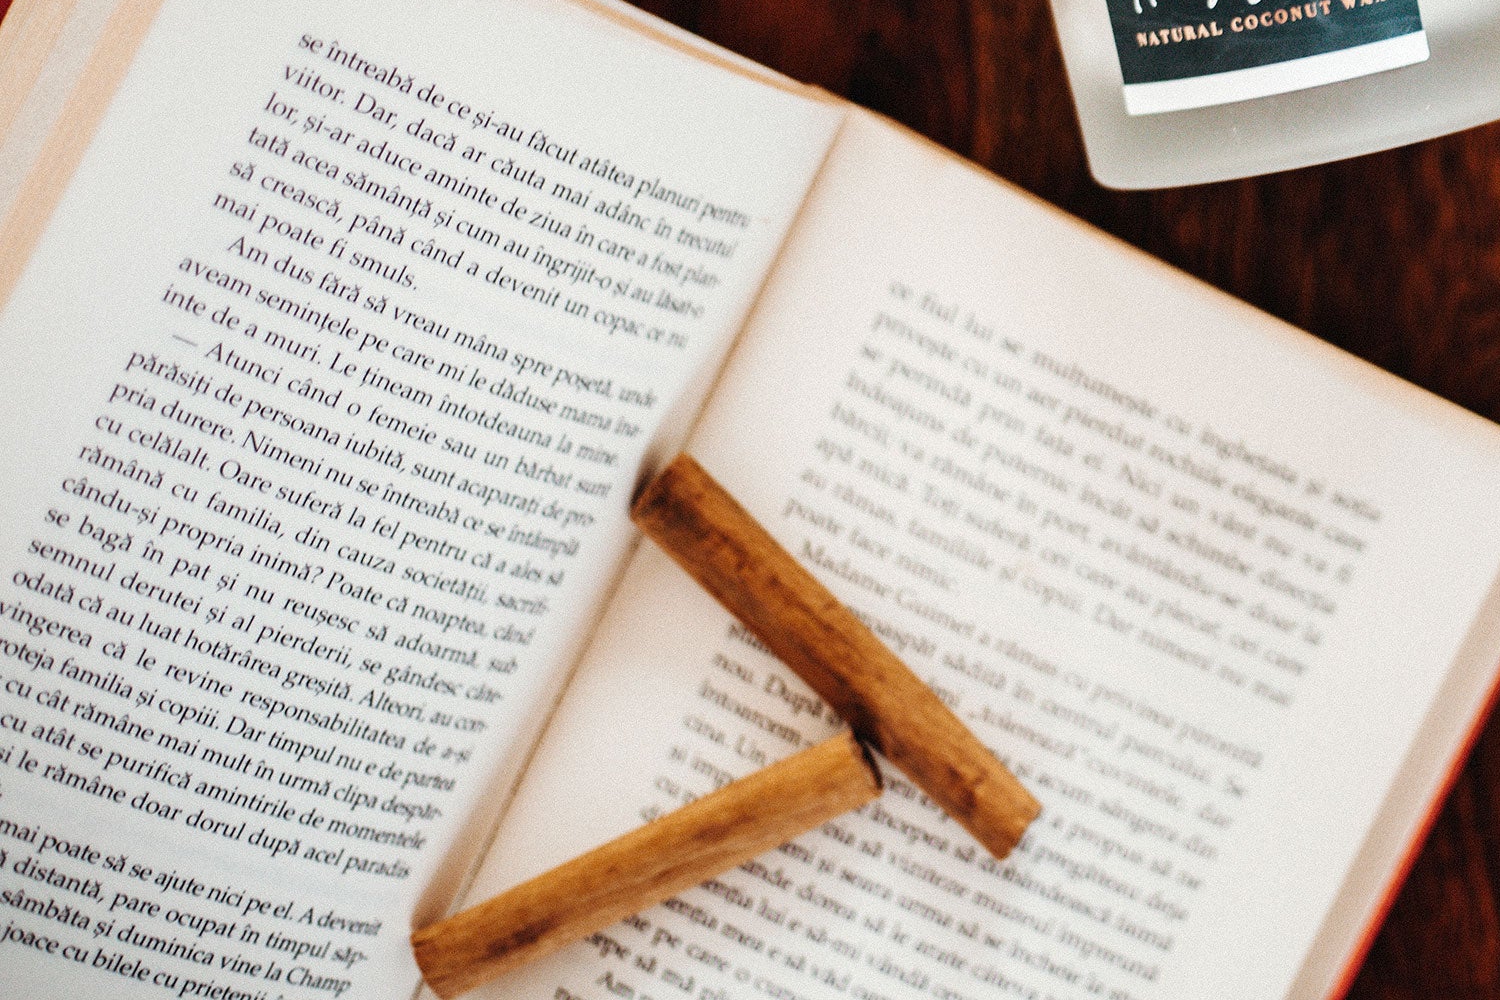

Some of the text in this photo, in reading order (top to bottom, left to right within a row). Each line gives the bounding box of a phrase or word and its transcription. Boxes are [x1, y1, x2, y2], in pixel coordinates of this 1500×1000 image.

[1134, 20, 1224, 48] NATURAL
[282, 63, 547, 192] viitor. Dar, dacă ar căuta
[296, 32, 580, 167] se întreabă de ce și-au făcut
[246, 124, 531, 260] tată acea sămânță și cum au
[261, 89, 529, 221] lor, și-ar aduce aminte de
[210, 191, 418, 291] mai poate fi smuls.
[227, 160, 480, 278] să crească, până când a
[176, 255, 469, 383] aveam semințele pe care mi
[224, 233, 451, 341] Am dus fără să vreau
[159, 281, 434, 408] inte de a muri. Le țineam
[202, 339, 438, 446] Atunci când o femeie
[105, 381, 380, 498] pria durere. Nimeni nu se
[121, 350, 406, 475] părăsiți de persoana iubită,
[76, 443, 397, 576] rămână cu familia, din cauza
[93, 413, 367, 530] cu celălalt. Oare suferă la
[42, 505, 361, 635] se bagă în pat și nu reușesc
[60, 475, 325, 585] cându-și propria inimă?
[10, 569, 282, 680] odată că au luat hotărârea
[26, 537, 353, 671] semnul derutei și al pierderii,
[4, 672, 254, 775] cu cât rămâne mai mult
[56, 654, 134, 700] familia
[133, 687, 159, 709] și
[156, 696, 220, 731] copiii.
[223, 712, 267, 744] Dar
[100, 638, 129, 662] că
[132, 645, 157, 672] le
[162, 662, 234, 699] revine
[0, 711, 194, 791] cu atât se purifică
[14, 746, 40, 774] le
[39, 761, 127, 805] rămâne
[128, 789, 184, 822] doar
[183, 807, 248, 842] dorul
[10, 854, 106, 905] distantă,
[105, 890, 162, 919] pare
[34, 831, 102, 866] poate
[100, 852, 130, 875] să
[126, 862, 154, 883] se
[152, 868, 206, 898] ajute
[0, 885, 216, 967] sâmbăta și duminica
[0, 918, 152, 983] joace cu bilele
